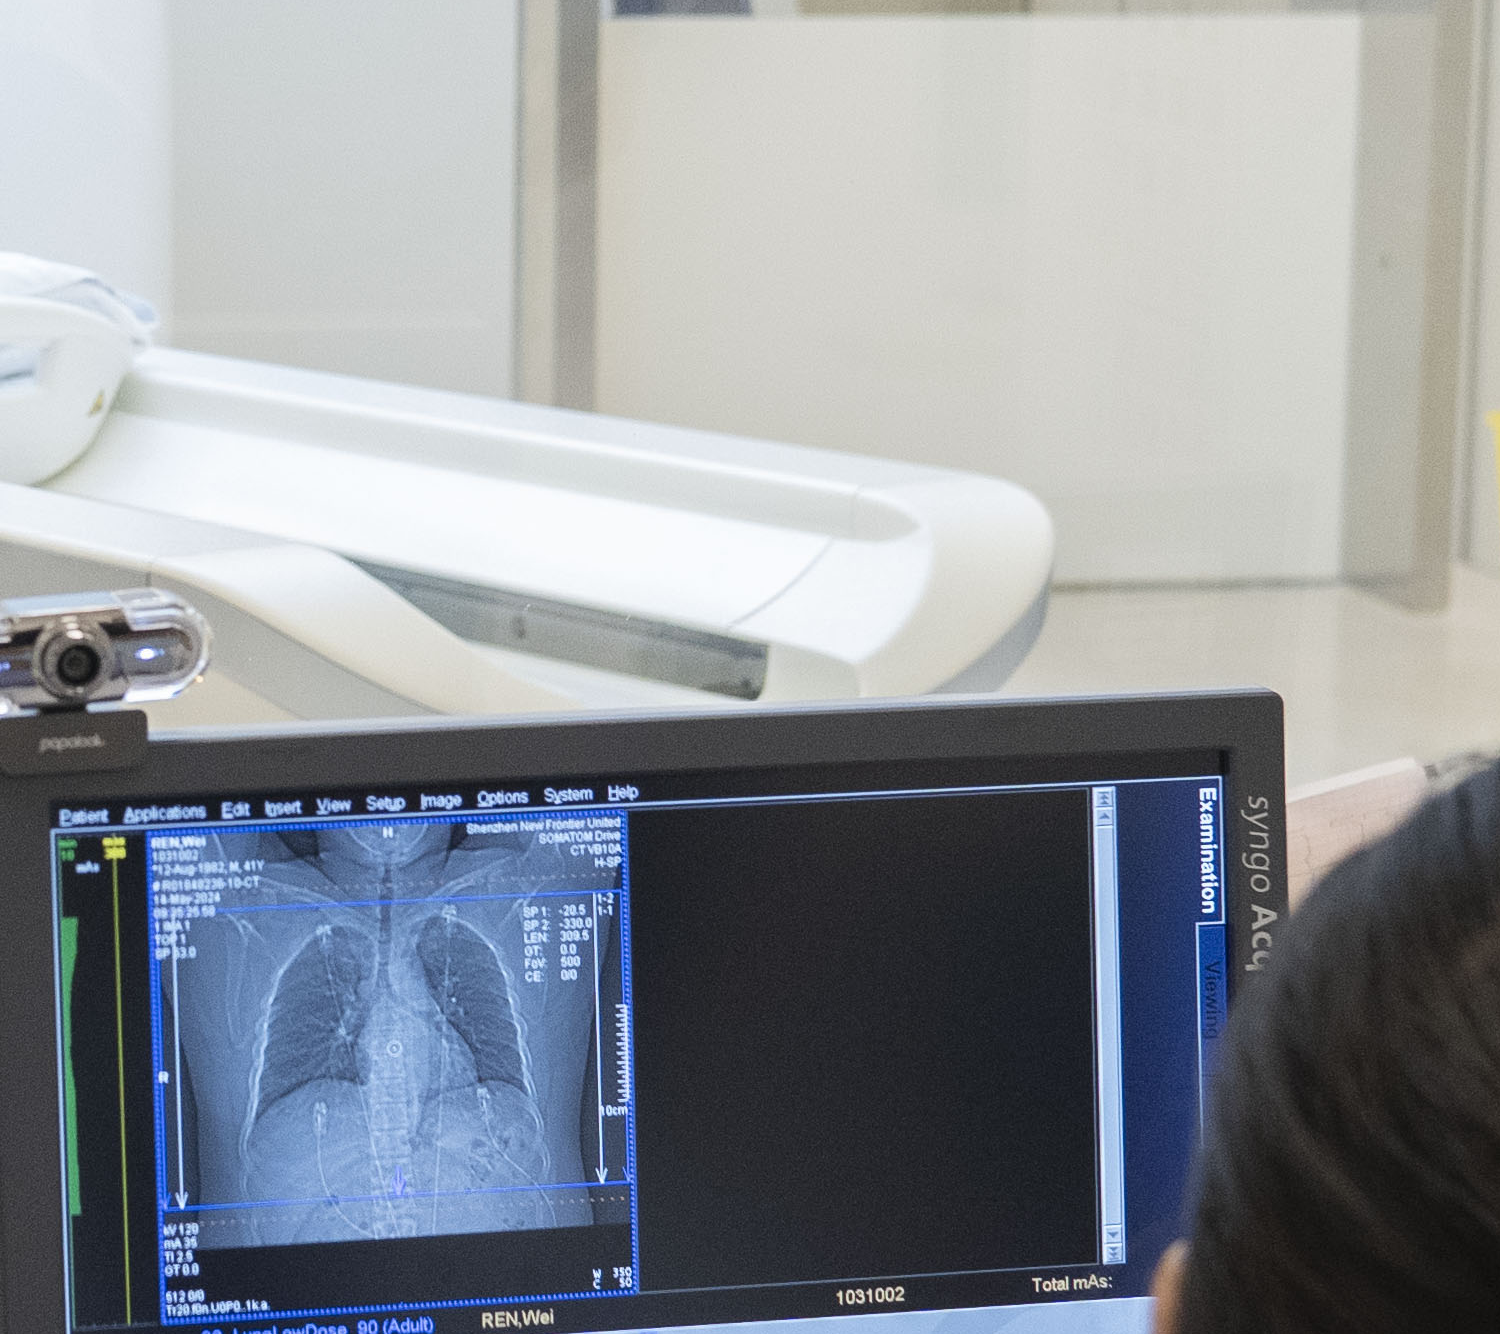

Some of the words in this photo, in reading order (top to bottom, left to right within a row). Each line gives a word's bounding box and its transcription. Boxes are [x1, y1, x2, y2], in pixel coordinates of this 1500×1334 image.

[58, 808, 109, 827] Patient
[123, 804, 207, 825] Applications
[220, 801, 251, 820] Edit
[264, 799, 303, 818] Insert
[316, 798, 352, 816] View
[366, 794, 406, 813] Setup
[420, 792, 464, 811] Image
[477, 788, 529, 809] Options
[544, 785, 594, 805] System
[607, 784, 639, 803] Help
[466, 821, 518, 836] Shenzhen
[520, 819, 544, 832] New
[546, 817, 586, 831] Frontier
[587, 815, 622, 829] United
[538, 831, 594, 845] SOMATOM
[595, 829, 622, 842] Drive
[1240, 794, 1273, 893] syngo
[1197, 786, 1220, 914] Examination
[523, 906, 539, 919] SP
[523, 919, 539, 932] SP
[560, 955, 581, 969] 500
[1202, 960, 1223, 1040] Viewing
[612, 1266, 633, 1278] 350
[1031, 1275, 1070, 1293] Total
[1072, 1273, 1114, 1291] mAs:
[834, 1285, 906, 1307] 1031002
[480, 1308, 555, 1331] REN,Wei
